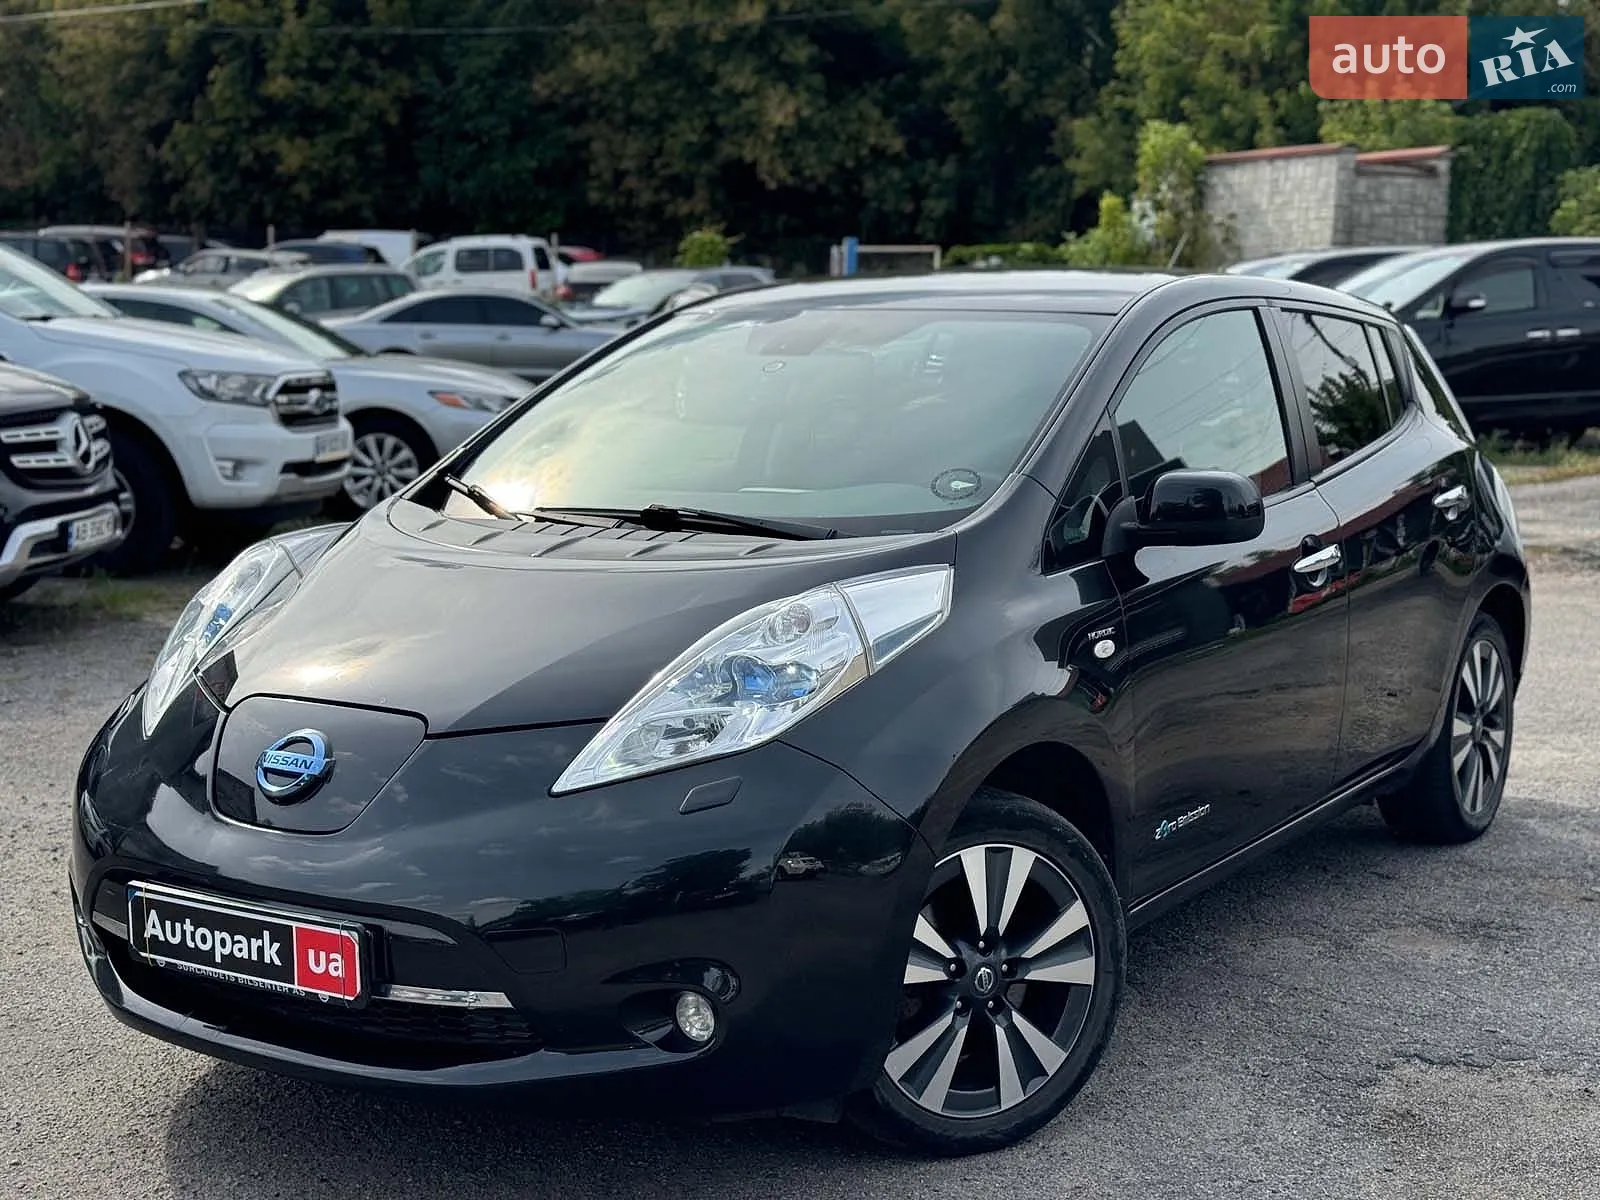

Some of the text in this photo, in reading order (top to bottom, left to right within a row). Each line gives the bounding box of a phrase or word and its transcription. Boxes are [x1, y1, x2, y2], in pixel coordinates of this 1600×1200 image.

[262, 751, 314, 770] NISSAN
[144, 909, 345, 978] Autopark ua
[292, 987, 306, 997] AS
